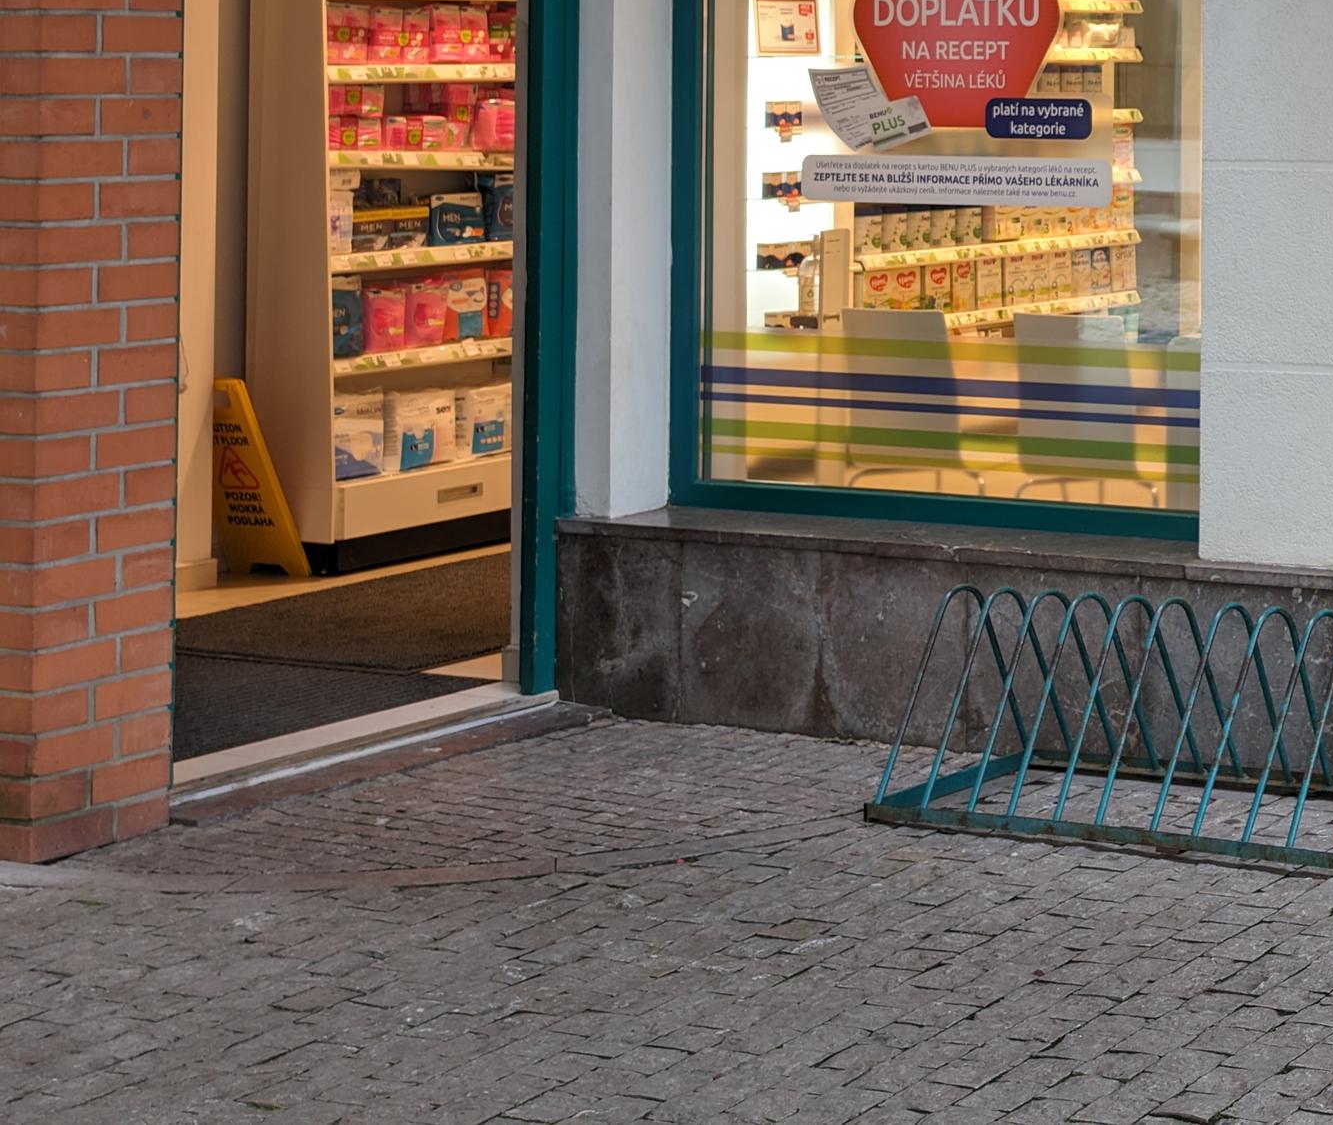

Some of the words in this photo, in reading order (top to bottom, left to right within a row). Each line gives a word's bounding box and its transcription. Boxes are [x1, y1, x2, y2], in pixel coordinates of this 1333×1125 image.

[901, 41, 931, 59] NA
[936, 41, 1009, 60] RECEPT
[904, 72, 966, 89] VĚTŠINA
[969, 68, 1007, 89] LÉKŮ
[993, 102, 1019, 118] platí
[1021, 106, 1035, 116] na
[1037, 102, 1084, 119] vybrané
[872, 115, 906, 135] PLUS
[1010, 121, 1066, 137] kategorie
[814, 172, 857, 182] ZEPTEJTE
[859, 173, 870, 182] SE
[872, 174, 884, 183] NA
[887, 171, 915, 184] BLIŽŠÍ
[916, 174, 970, 185] INFORMACE
[972, 174, 1003, 186] PŘÍMO
[1005, 174, 1043, 186] VAŠEHO
[1045, 175, 1099, 187] LÉKÁRNÍKA
[213, 424, 242, 433] UTION
[227, 516, 275, 527] PODLAHA
